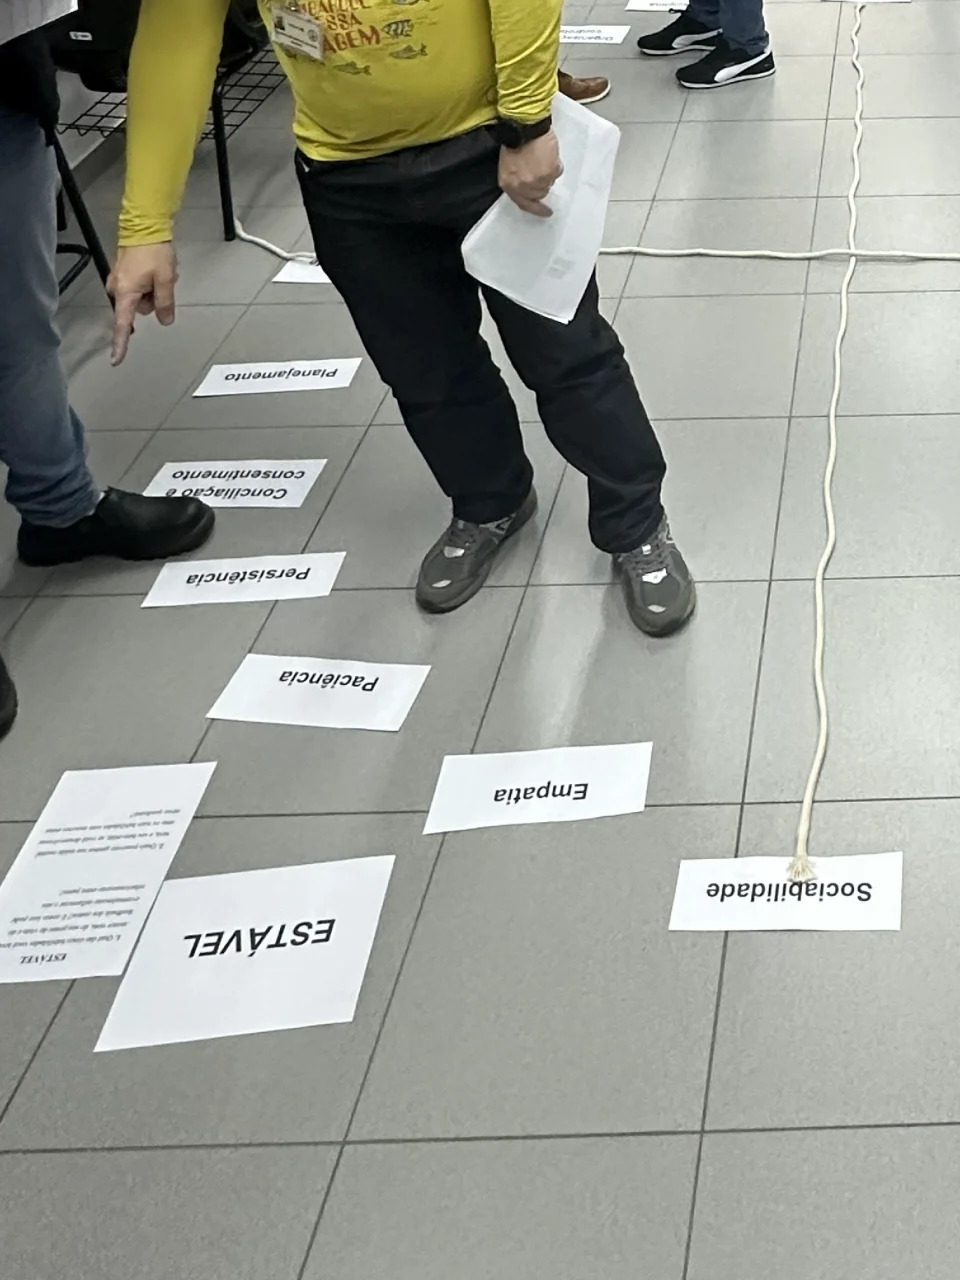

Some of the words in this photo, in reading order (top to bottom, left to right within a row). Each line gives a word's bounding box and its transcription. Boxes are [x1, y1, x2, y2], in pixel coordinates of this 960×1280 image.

[323, 24, 381, 53] AGEM
[224, 367, 338, 382] Planejamento
[171, 468, 306, 482] consentimento
[186, 565, 311, 587] Persistência
[278, 670, 380, 693] Paciência
[493, 780, 589, 803] Empatia
[706, 878, 873, 904] Sociabilidade
[183, 918, 336, 959] ESTÁVEL
[19, 952, 67, 966] ESTÁVEL
